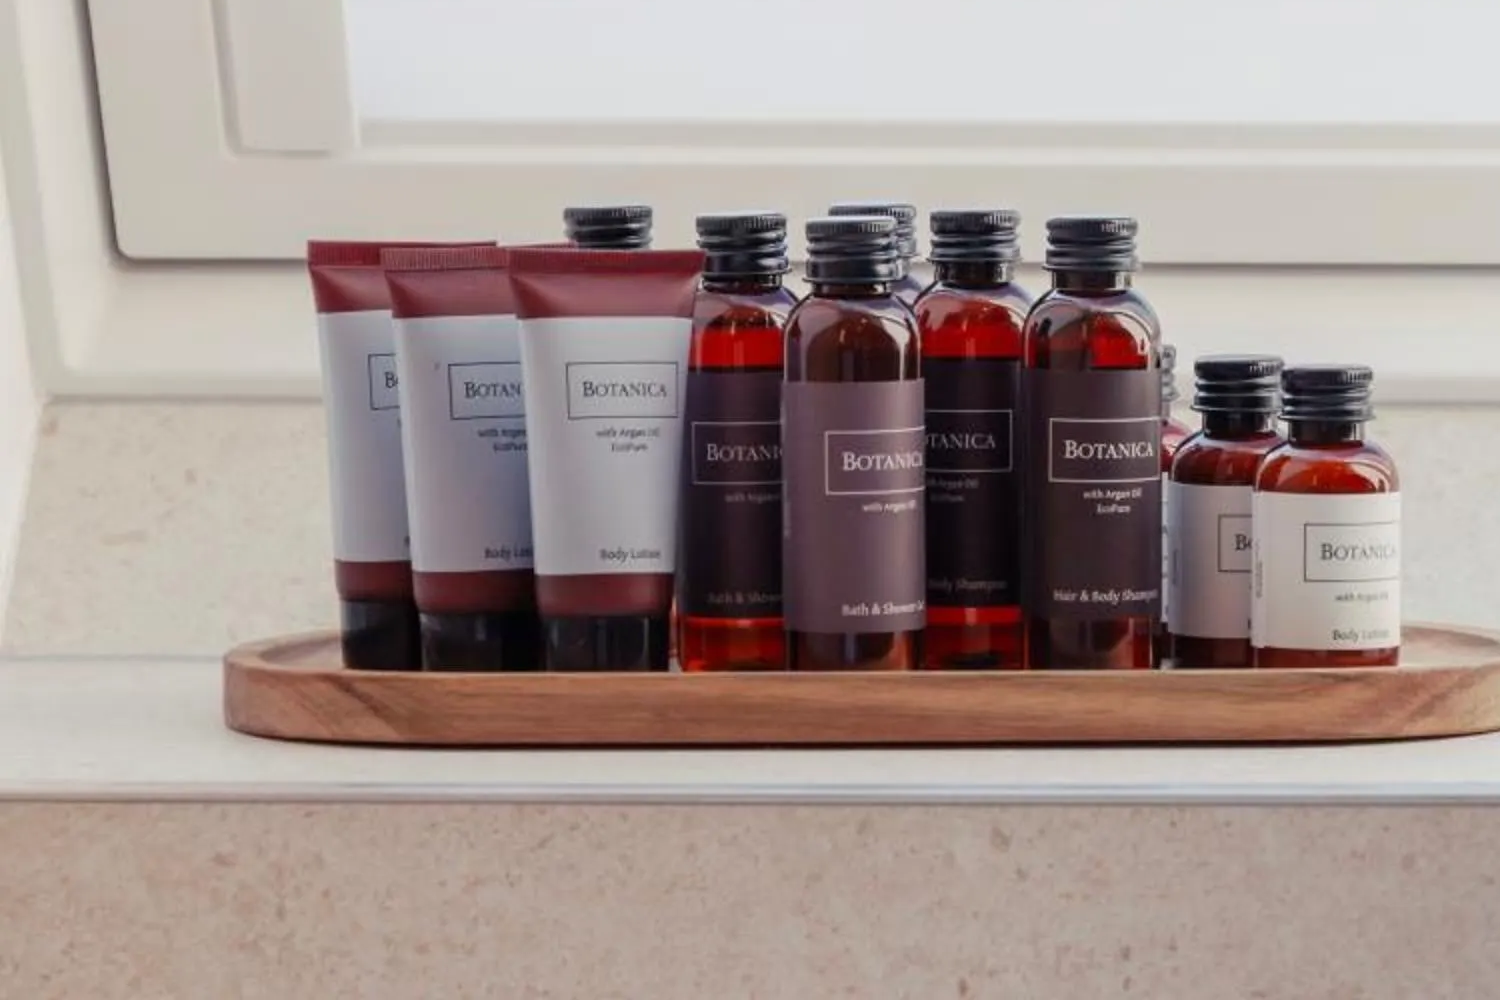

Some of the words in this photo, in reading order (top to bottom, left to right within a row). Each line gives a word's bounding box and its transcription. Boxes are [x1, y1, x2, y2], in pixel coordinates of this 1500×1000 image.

[464, 381, 522, 399] BOTAN
[583, 380, 667, 398] BOTANICA
[925, 432, 997, 450] TANICA
[1064, 439, 1153, 459] BOTANICA
[707, 443, 783, 462] BOTANI
[1106, 488, 1131, 502] Argan
[599, 546, 628, 564] Body
[1091, 588, 1120, 606] Body
[842, 602, 869, 616] Bath
[1332, 628, 1359, 644] Body
